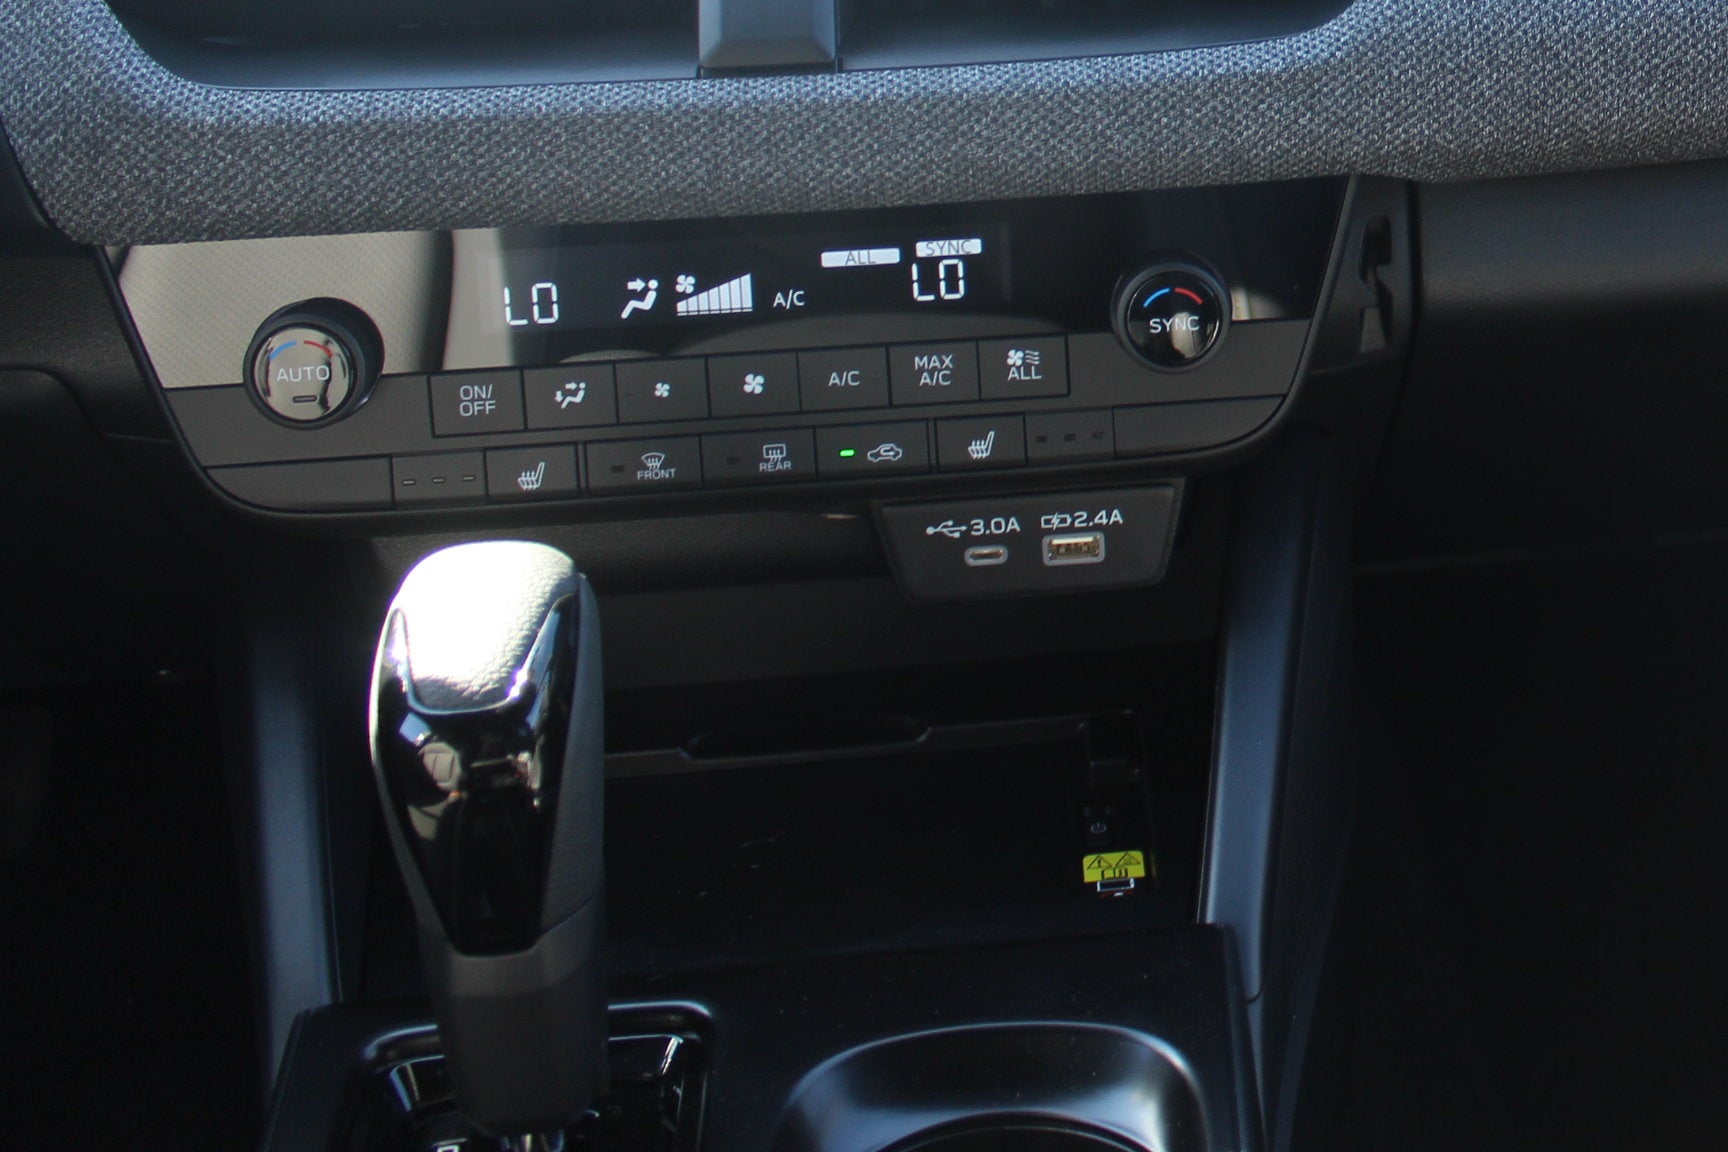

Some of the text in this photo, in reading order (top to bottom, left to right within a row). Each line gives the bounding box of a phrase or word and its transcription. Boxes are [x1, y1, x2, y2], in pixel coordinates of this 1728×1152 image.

[925, 240, 971, 256] SYNC
[845, 251, 876, 267] ALL
[911, 259, 965, 302] LO
[504, 282, 558, 326] LO
[773, 291, 805, 310] A/C
[1149, 315, 1200, 334] SYNC
[914, 354, 954, 370] MAX
[276, 364, 330, 383] AUTO
[828, 371, 860, 387] A/C
[919, 370, 952, 386] A/C
[1007, 365, 1042, 381] ALL
[459, 383, 493, 401] ON/
[459, 400, 496, 417] OFF
[637, 468, 676, 480] FRONT
[759, 461, 792, 472] REAR
[970, 517, 1021, 536] 3.0A
[1073, 509, 1124, 527] 2.4A
